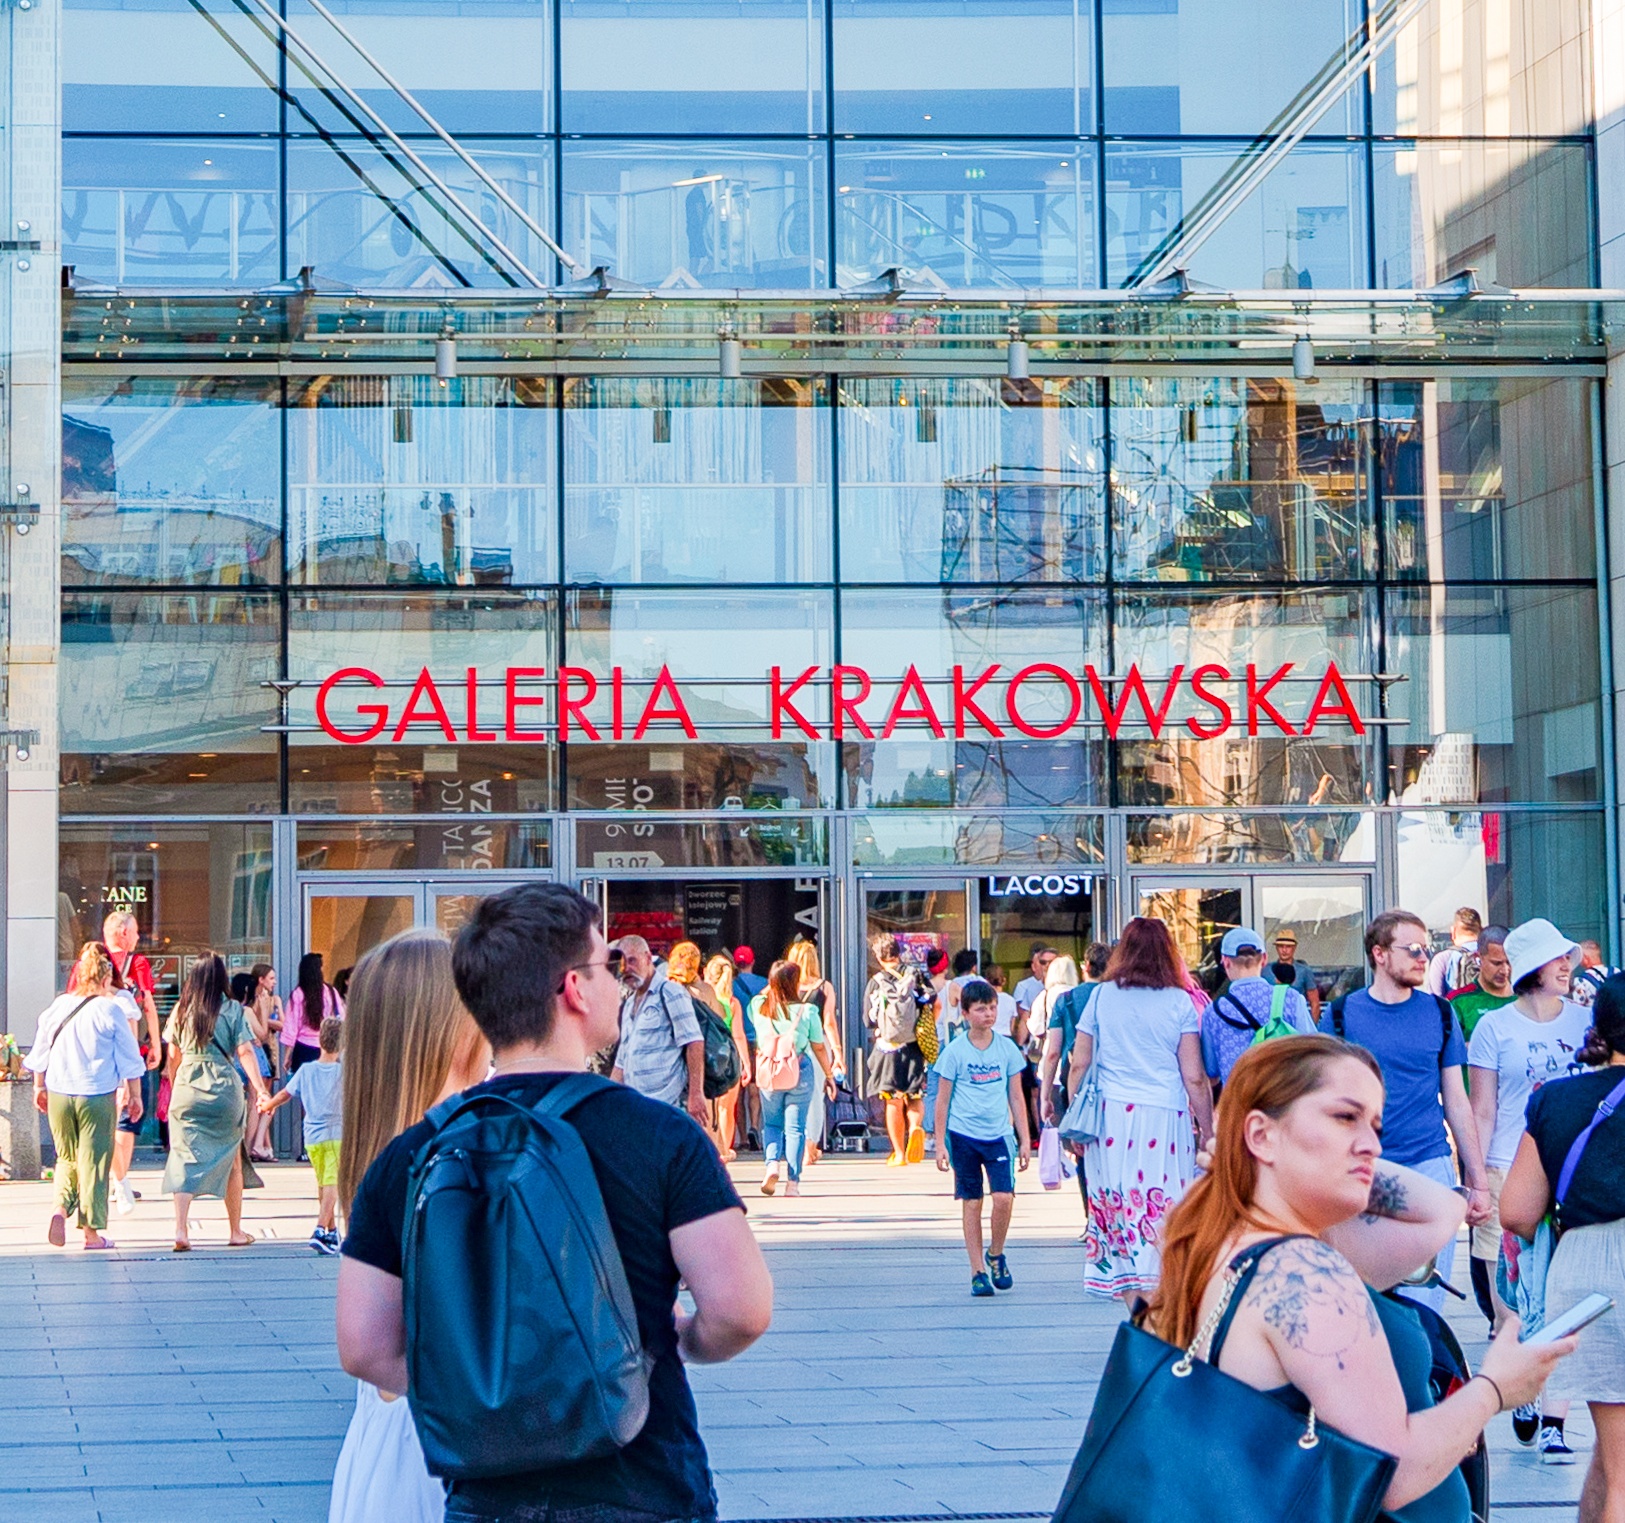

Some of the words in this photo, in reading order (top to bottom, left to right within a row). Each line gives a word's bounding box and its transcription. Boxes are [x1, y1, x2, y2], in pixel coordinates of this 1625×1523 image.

[315, 664, 698, 744] GALERIA
[771, 660, 1366, 741] KRAKOWSKA
[988, 874, 1093, 896] LACOST
